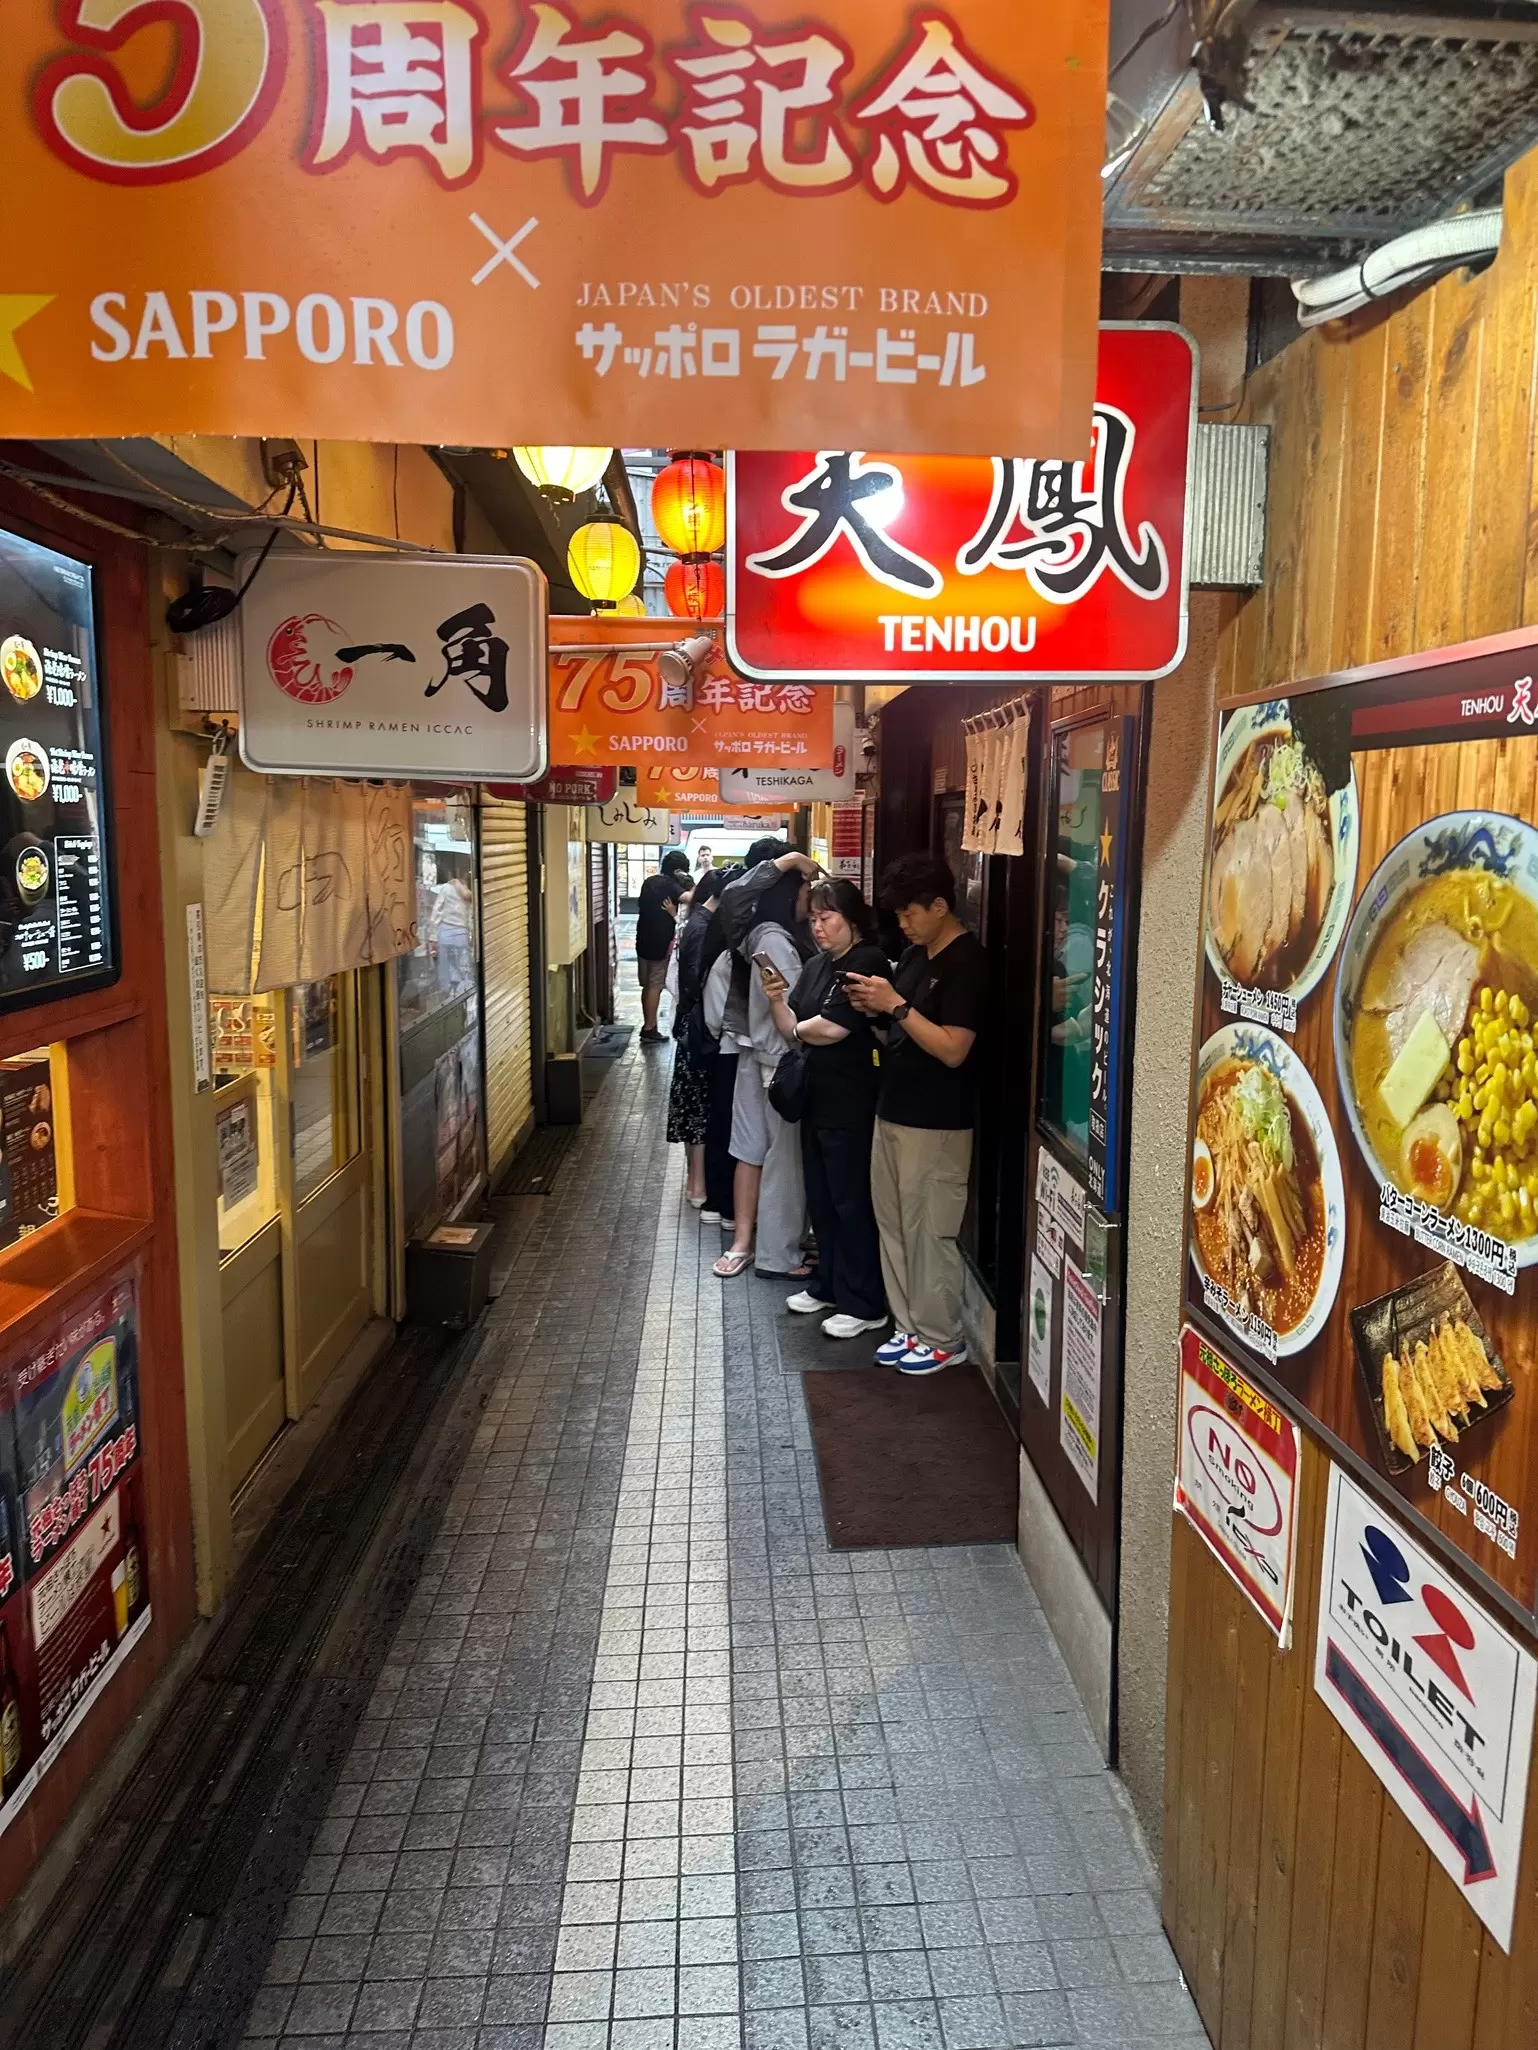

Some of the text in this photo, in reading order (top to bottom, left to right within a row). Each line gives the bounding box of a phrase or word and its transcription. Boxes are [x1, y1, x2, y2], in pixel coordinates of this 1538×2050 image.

[576, 282, 989, 317] JAPAN'S OLDEST BRAND
[89, 290, 455, 371] SAPPORO
[575, 321, 987, 388] サッポロ ラガービール
[335, 602, 510, 713] 一角
[878, 615, 1037, 653] TENHOU
[306, 718, 473, 735] SHRIMP RAMEN ICCAC
[1460, 694, 1505, 717] TENHOU
[608, 735, 689, 752] SAPPORO
[674, 792, 718, 802] SAPPORO
[755, 776, 814, 786] TESHIKAGA
[1207, 1453, 1255, 1512] Smoking
[1208, 1426, 1257, 1497] NO
[1430, 1445, 1455, 1480] 餃子
[1476, 1483, 1508, 1530] 600円
[1341, 1578, 1486, 1752] TOILET
